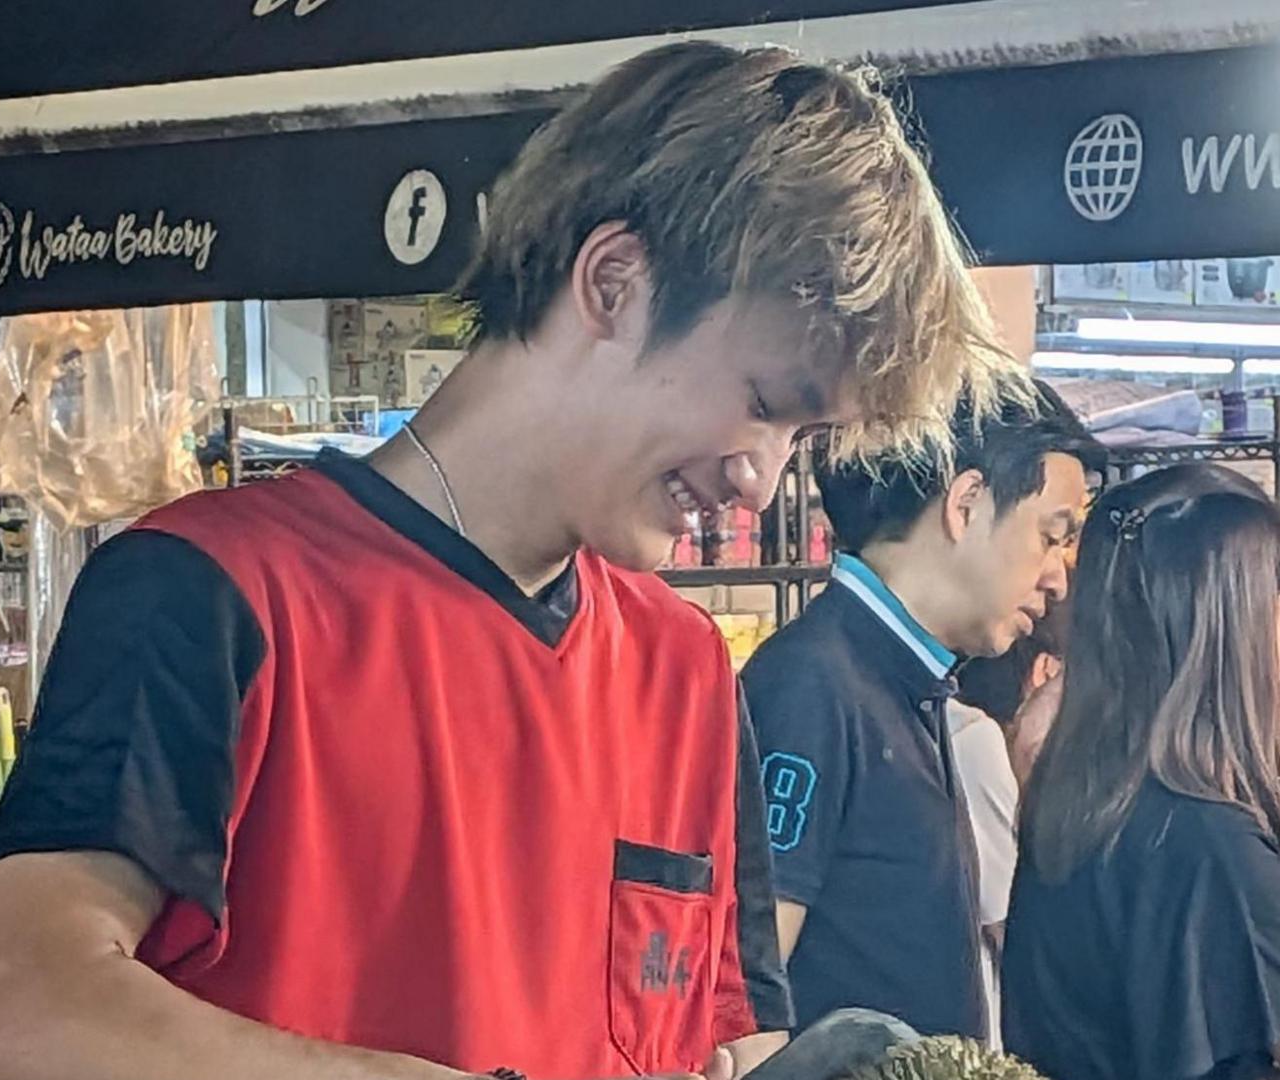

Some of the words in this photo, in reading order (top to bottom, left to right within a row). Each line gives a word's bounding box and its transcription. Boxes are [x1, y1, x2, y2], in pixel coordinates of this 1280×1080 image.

[20, 210, 113, 279] Wataa
[114, 210, 218, 270] Bakery
[760, 751, 817, 851] 8
